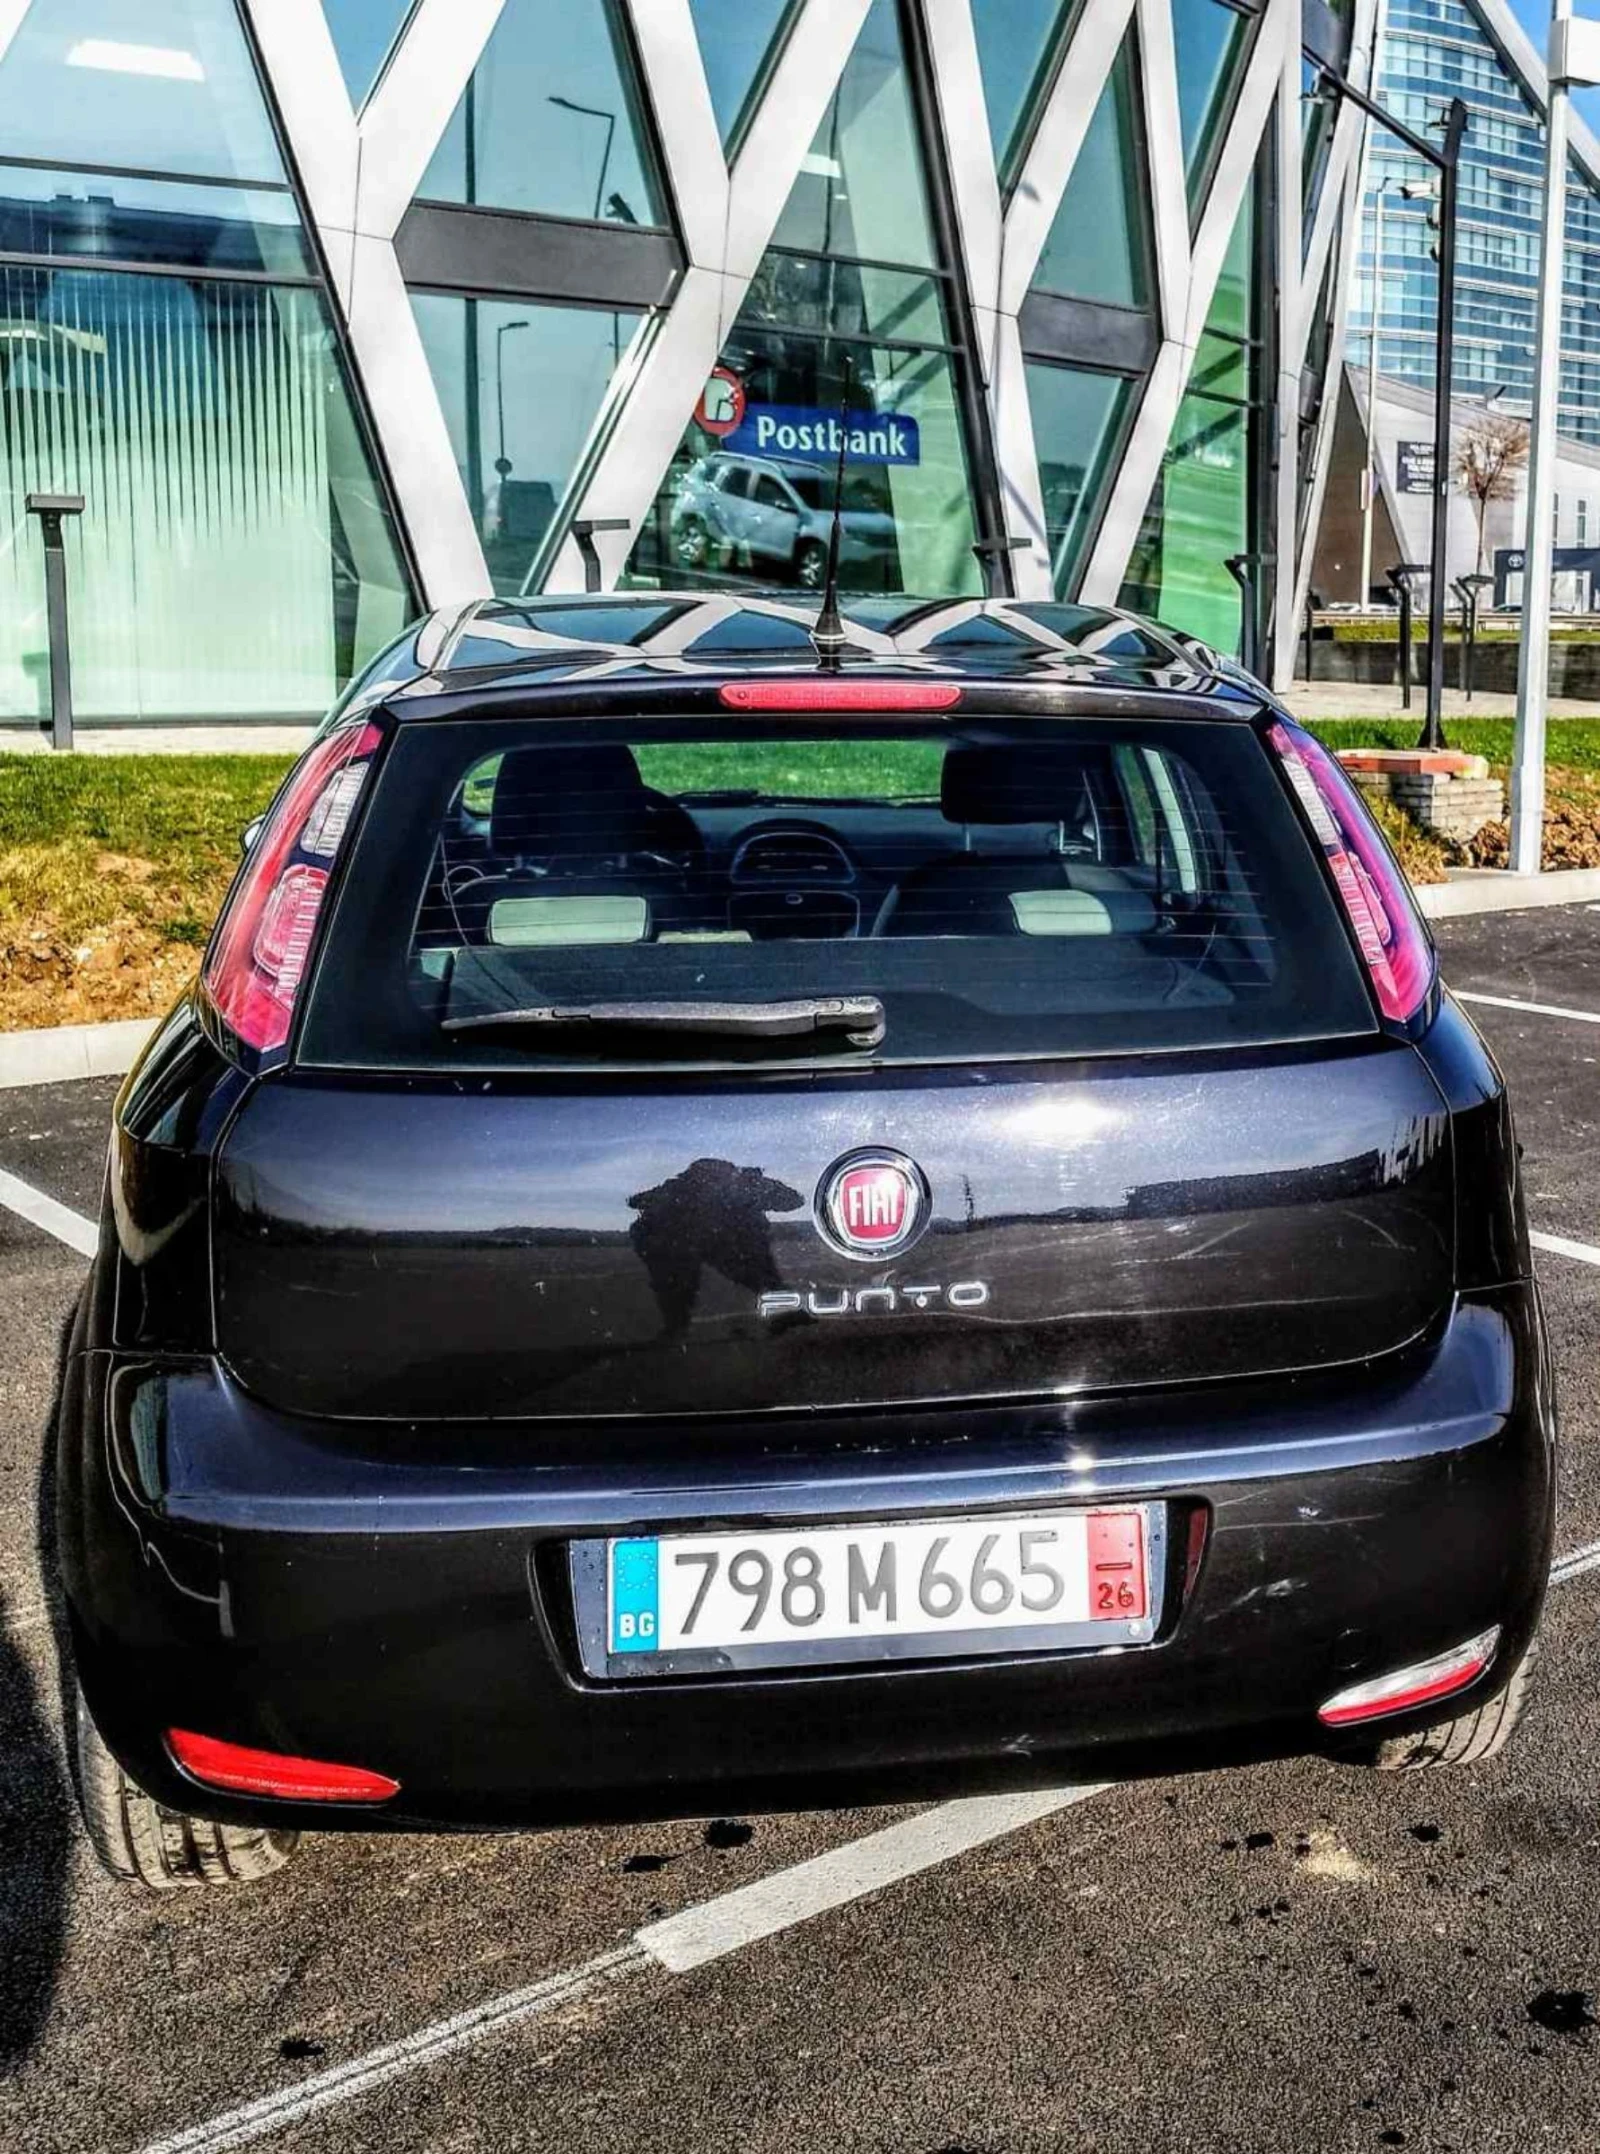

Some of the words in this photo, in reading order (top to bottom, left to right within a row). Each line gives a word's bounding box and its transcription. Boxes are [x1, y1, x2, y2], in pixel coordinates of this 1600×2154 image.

[757, 416, 906, 456] Postbank
[851, 1184, 899, 1226] FIAT
[760, 1282, 989, 1317] PUNTO
[675, 1546, 826, 1634] 798
[847, 1541, 898, 1624] M
[919, 1530, 1065, 1616] 665
[1097, 1582, 1134, 1609] 26
[619, 1612, 655, 1638] BG
